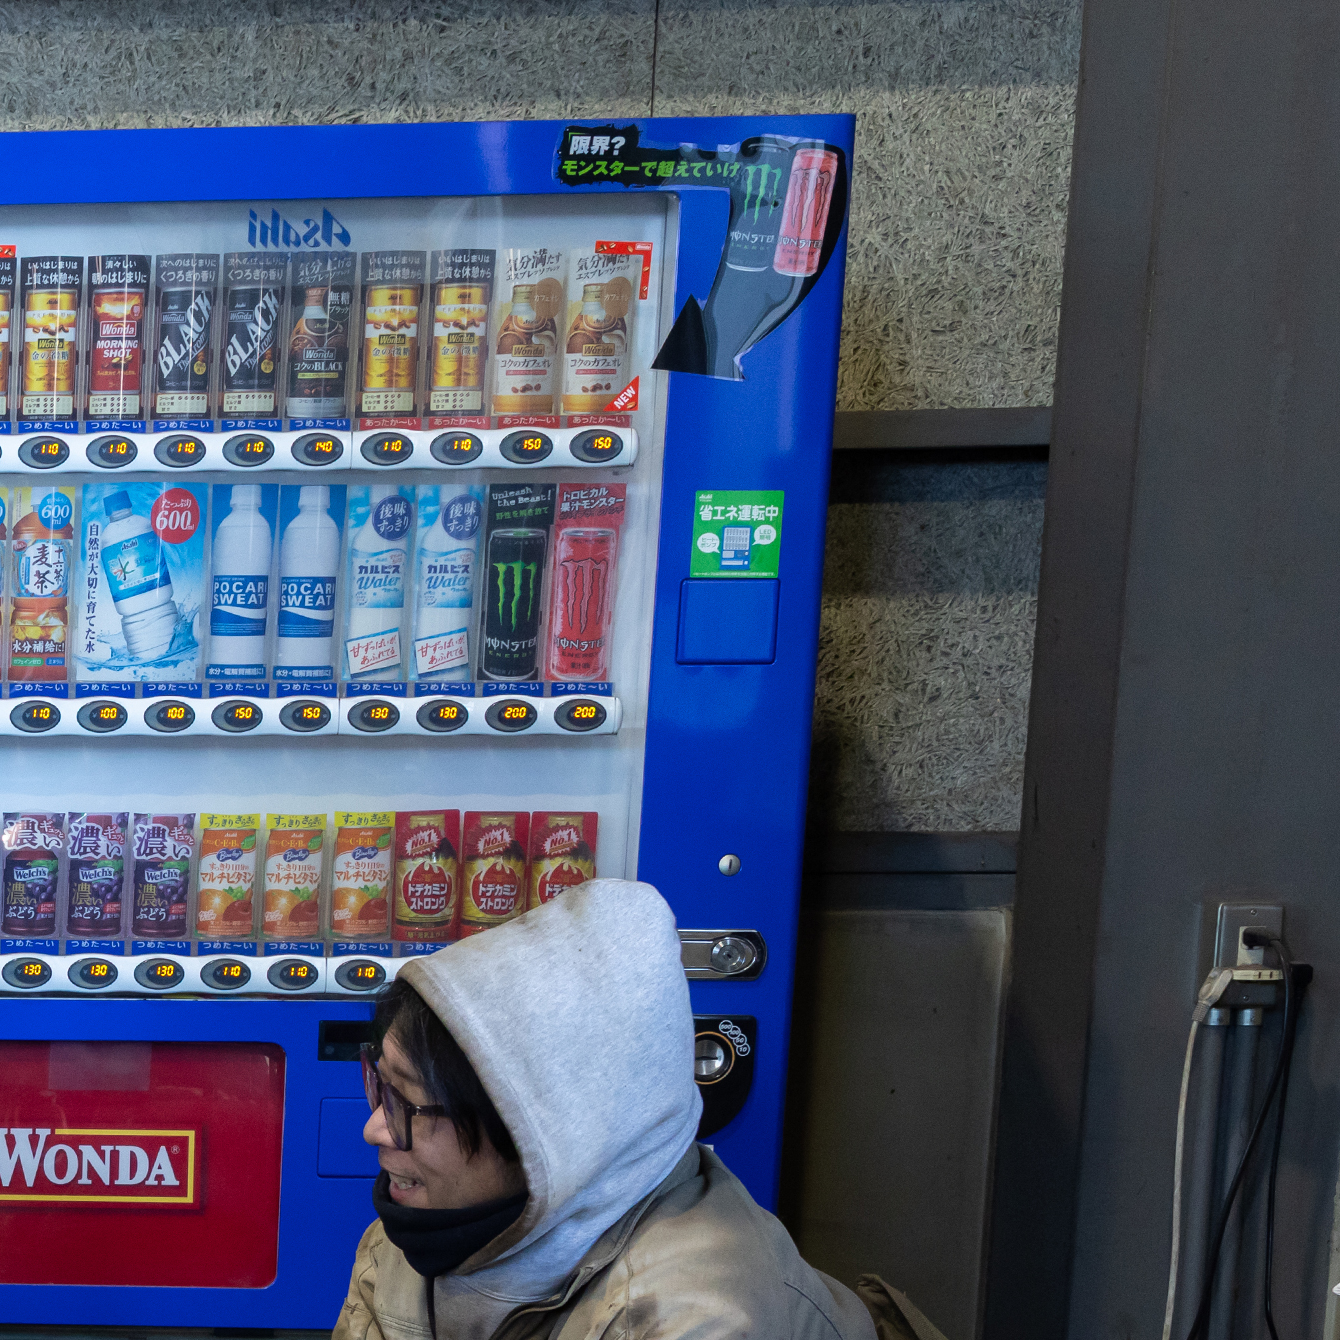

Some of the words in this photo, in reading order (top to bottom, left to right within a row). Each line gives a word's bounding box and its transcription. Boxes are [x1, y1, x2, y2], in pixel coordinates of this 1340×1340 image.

[562, 160, 740, 178] モンスターで超えていけ
[160, 259, 217, 267] 次へのはじまりに
[438, 254, 490, 263] いいはじまりは
[28, 261, 77, 270] いいはじまりは
[25, 273, 80, 285] 上質な休憩から
[92, 272, 147, 284] 朝のはじまりに
[160, 271, 216, 282] くつろぎの香り
[228, 269, 283, 281] くつろぎの香り
[435, 267, 491, 279] 上質な休憩から
[102, 322, 135, 335] Wonda
[159, 290, 211, 378] BLACK
[226, 289, 279, 377] BLACK
[97, 340, 138, 349] MORNING
[103, 349, 131, 358] SHOT
[614, 389, 636, 410] NEW
[41, 443, 59, 455] 110
[109, 442, 127, 454] 110
[177, 442, 195, 454] 110
[246, 441, 264, 453] 110
[315, 441, 333, 452] 140
[383, 440, 402, 451] 110
[453, 439, 471, 451] 110
[523, 439, 541, 450] 150
[593, 437, 611, 449] 150
[492, 487, 532, 500] Unleash
[518, 489, 551, 504] Beast!
[563, 487, 608, 500] トロピカル
[162, 498, 191, 508] たっぷり
[560, 498, 624, 513] 果汁モンスター
[41, 505, 69, 519] 600
[380, 502, 407, 519] 後味
[449, 501, 477, 518] 後味
[699, 505, 778, 521] 省エネ運転中
[378, 518, 409, 533] すっきり
[447, 516, 479, 533] すっきり
[357, 565, 401, 574] カルピス
[428, 565, 470, 574] カルピス
[84, 523, 100, 653] 自然が大切に育てた水
[214, 582, 267, 593] POCARI
[357, 575, 401, 589] Water
[426, 575, 469, 589] Water
[281, 583, 334, 594] POCARI
[214, 594, 264, 604] SWEAT
[281, 595, 331, 606] SWEAT
[100, 708, 117, 719] 100
[167, 708, 184, 719] 100
[235, 708, 252, 718] 150
[303, 708, 320, 718] 150
[371, 707, 389, 718] 130
[439, 707, 457, 718] 130
[504, 707, 526, 718] 200
[574, 707, 596, 718] 200
[15, 869, 47, 879] Welch's
[81, 869, 113, 879] Welch's
[146, 870, 178, 881] Welch's
[200, 872, 254, 884] マルチビタミン
[266, 872, 320, 884] マルチビタミン
[335, 870, 389, 883] マルチビタミン
[408, 884, 447, 895] ドデカミン
[479, 884, 517, 895] ドデカミン
[410, 898, 446, 910] ストロング
[479, 898, 514, 910] ストロング
[6, 905, 35, 919] ぶどう
[71, 906, 101, 919] ぶどう
[136, 907, 166, 920] ぶどう
[25, 964, 41, 975] 130
[91, 964, 107, 976] 130
[157, 965, 174, 976] 130
